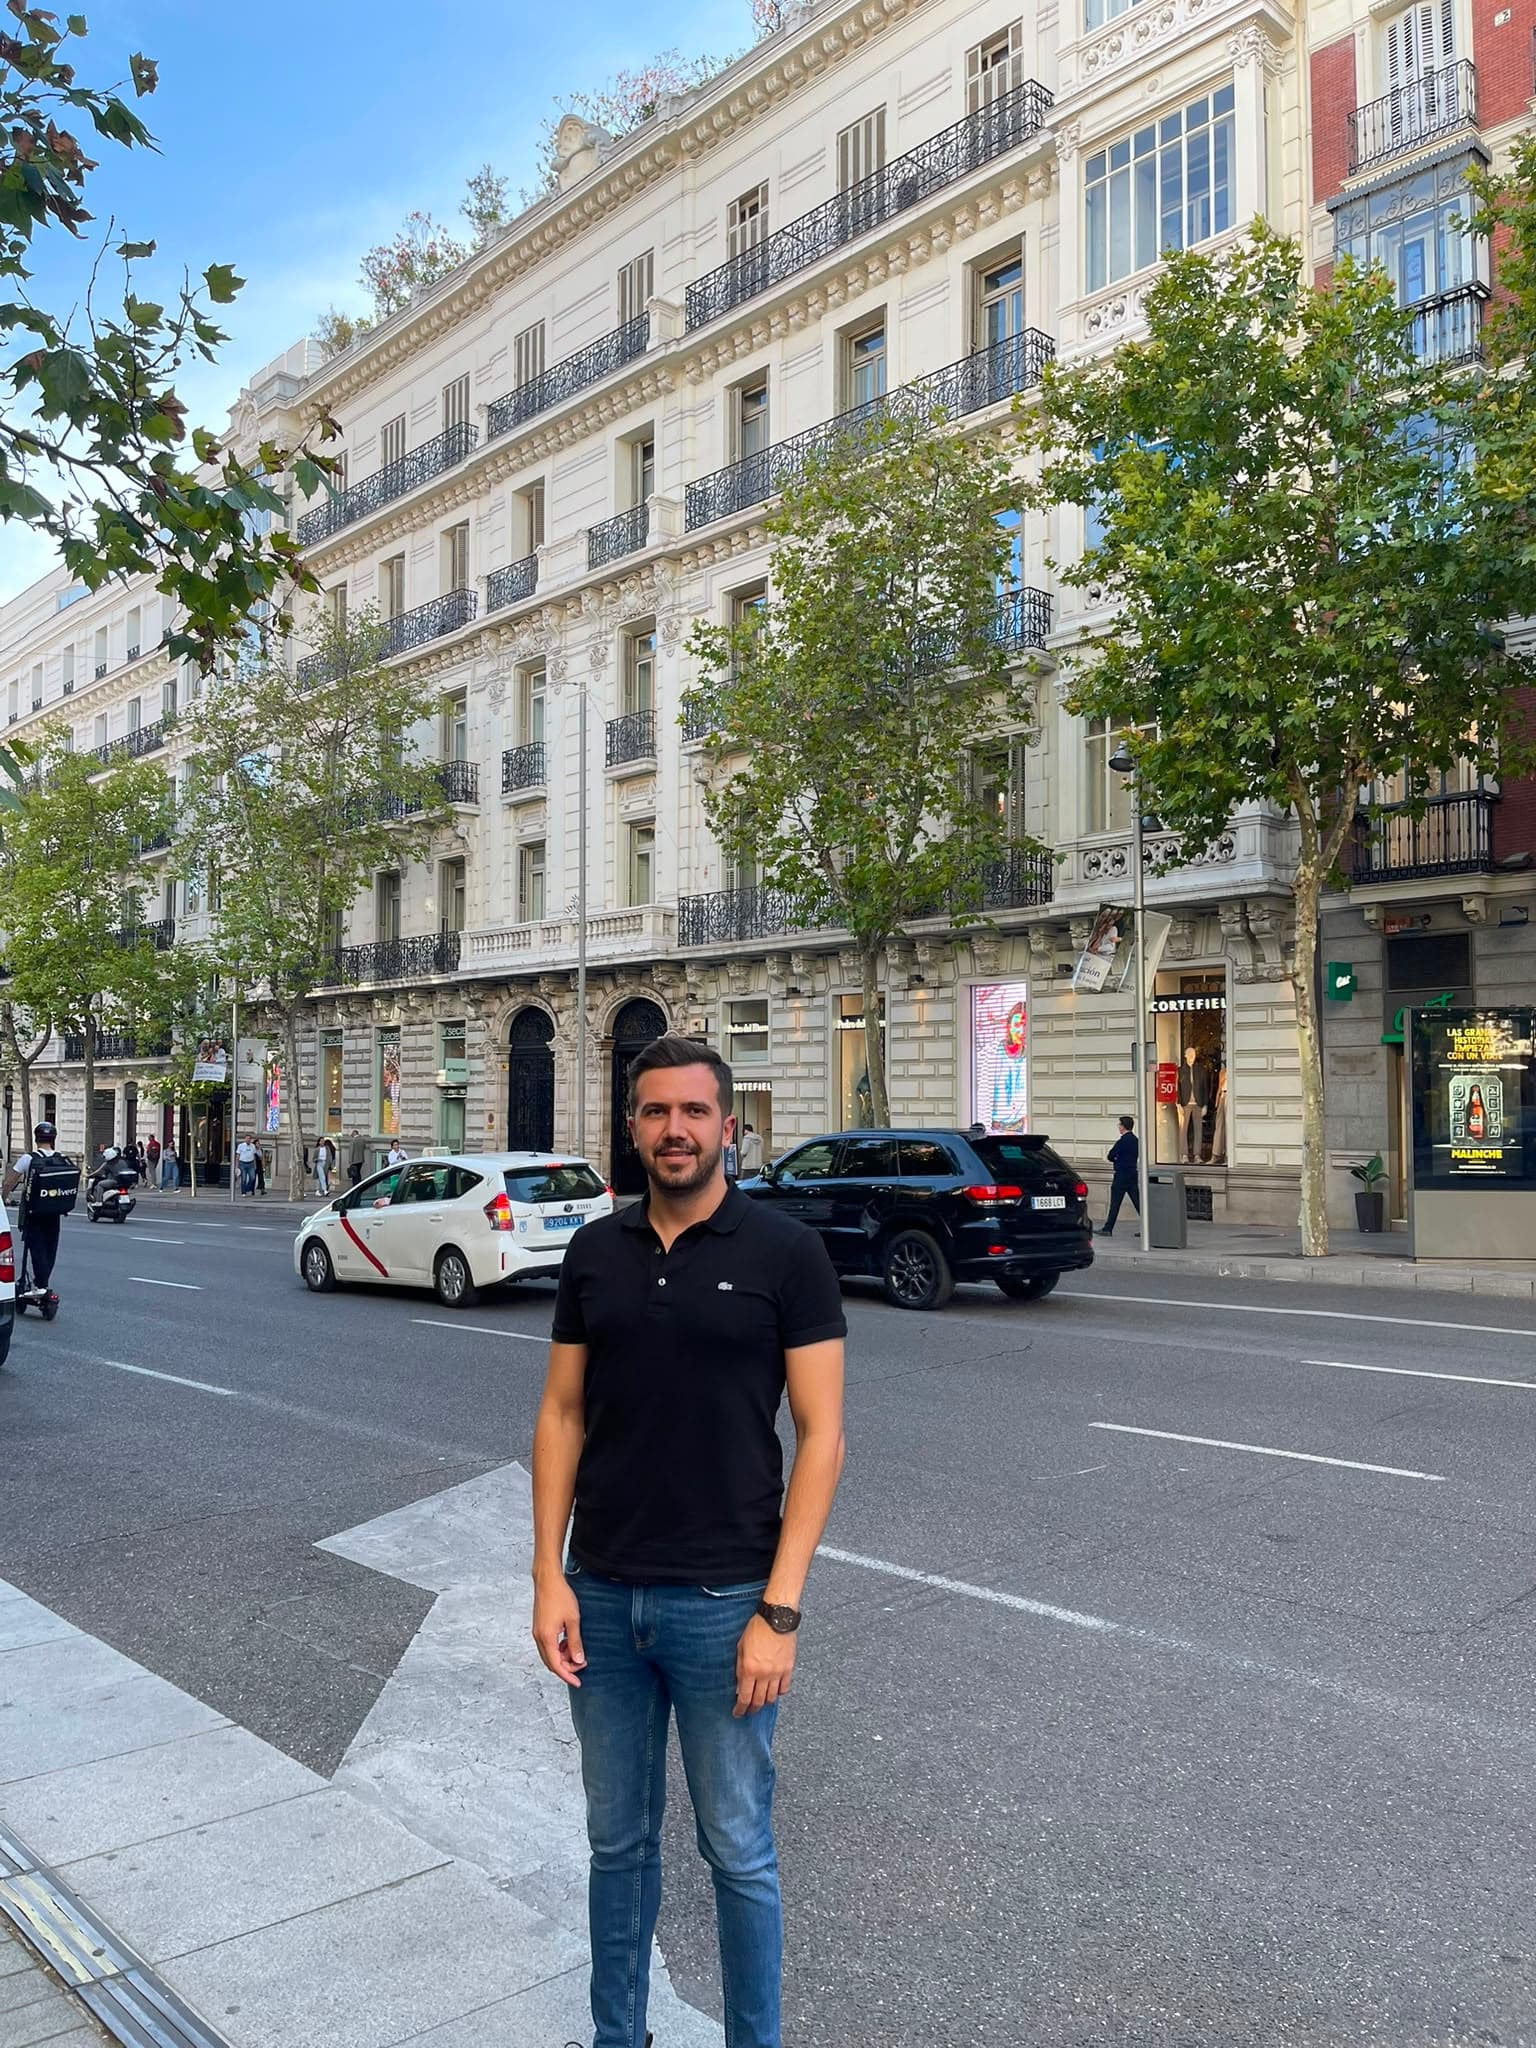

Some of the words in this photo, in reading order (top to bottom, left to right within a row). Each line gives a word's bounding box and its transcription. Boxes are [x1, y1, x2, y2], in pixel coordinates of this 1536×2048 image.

[1446, 1028, 1462, 1037] LAS
[1446, 1052, 1464, 1060] CON
[1466, 1052, 1479, 1060] UN
[733, 1082, 772, 1092] ORTEFIEL
[1451, 1149, 1503, 1159] MALINCHE
